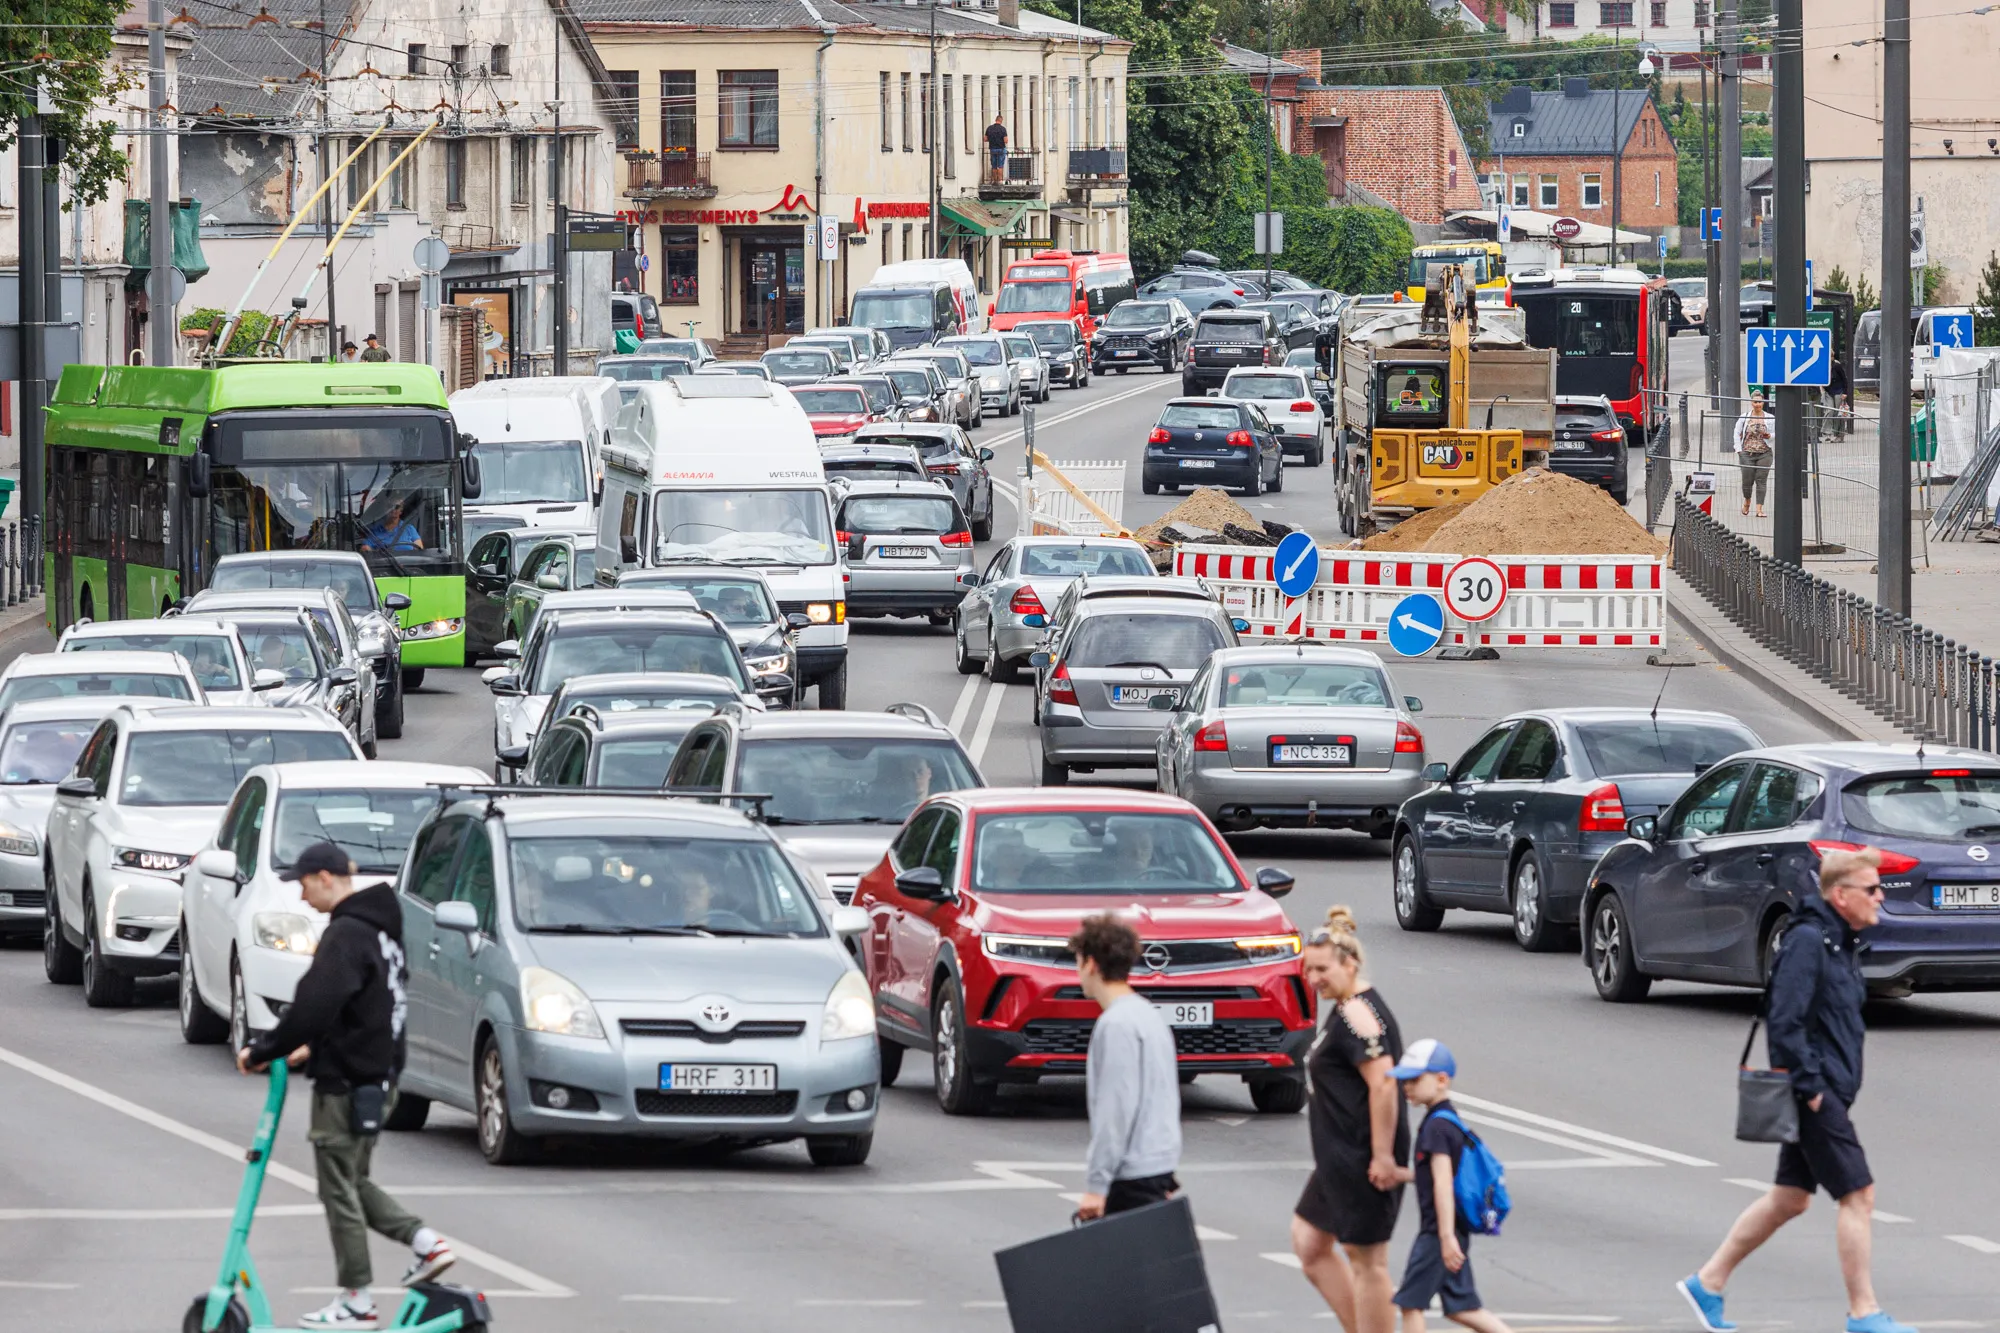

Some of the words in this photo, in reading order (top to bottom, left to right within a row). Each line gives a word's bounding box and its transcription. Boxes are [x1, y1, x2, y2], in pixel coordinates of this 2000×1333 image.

[615, 210, 658, 224] ATOS
[662, 210, 759, 224] REIKMENYS
[768, 213, 809, 221] TEIDA
[808, 234, 814, 245] 2
[827, 233, 835, 242] 20
[1570, 302, 1582, 314] 20
[1419, 437, 1478, 448] www.polcab.com
[1571, 441, 1585, 449] 510
[1423, 446, 1454, 464] CAT
[663, 471, 714, 479] ALEMANIA
[884, 547, 904, 556] HBT
[909, 547, 926, 556] 775
[1458, 577, 1493, 603] 30
[1122, 689, 1149, 700] MOJ
[1290, 746, 1320, 759] NCC
[1322, 746, 1346, 759] 352
[1944, 887, 1979, 903] HMT
[1175, 1006, 1207, 1022] 961
[674, 1068, 718, 1086] HRF
[734, 1068, 769, 1086] 311
